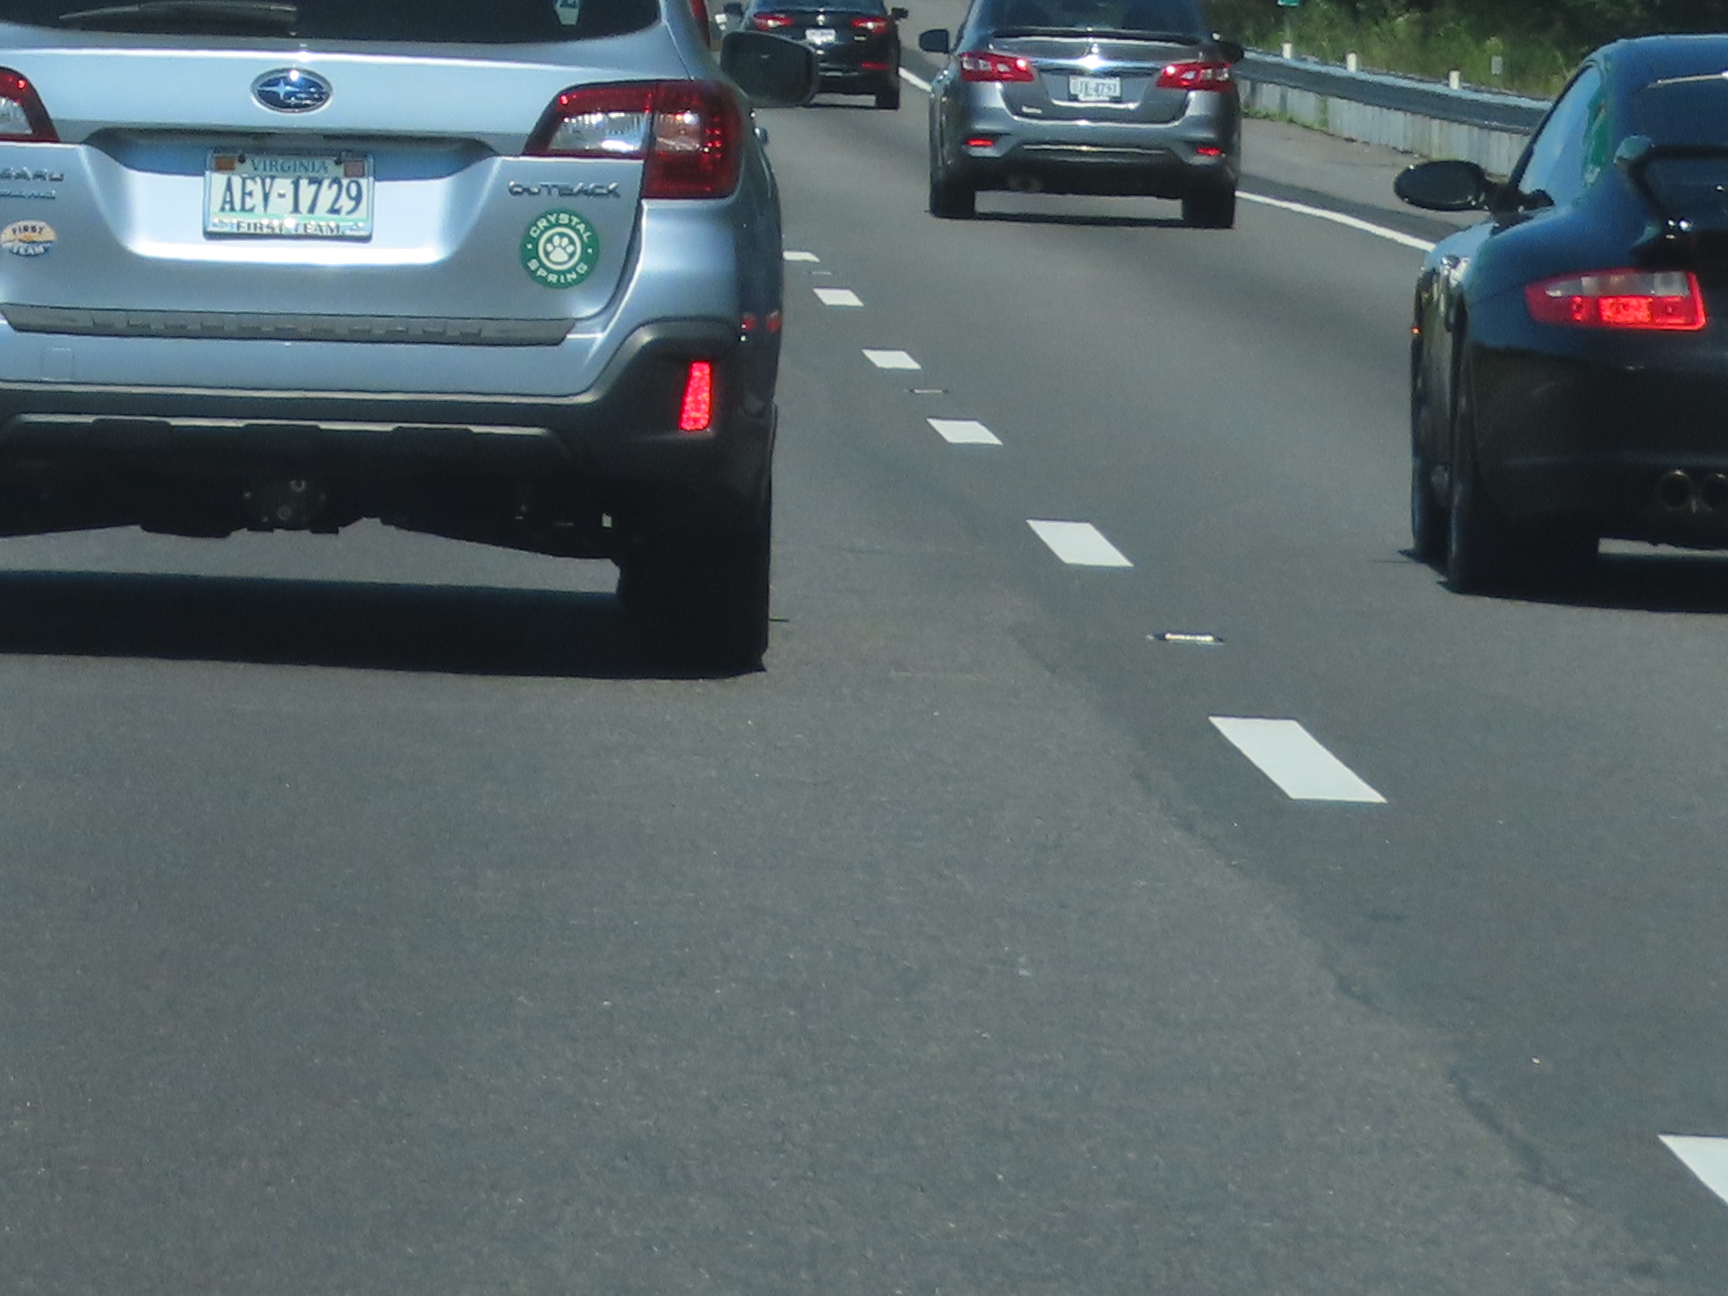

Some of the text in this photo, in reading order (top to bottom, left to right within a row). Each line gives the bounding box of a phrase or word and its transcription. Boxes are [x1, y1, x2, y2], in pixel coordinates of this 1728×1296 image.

[250, 158, 331, 174] VIRGINIA
[219, 175, 364, 216] AEV-1729
[507, 180, 622, 199] OUTBACK
[11, 224, 45, 236] FIRST
[235, 220, 285, 234] FIRST
[528, 211, 593, 244] CRYSTAL
[12, 244, 45, 257] TEAM
[526, 257, 589, 285] SPRING
